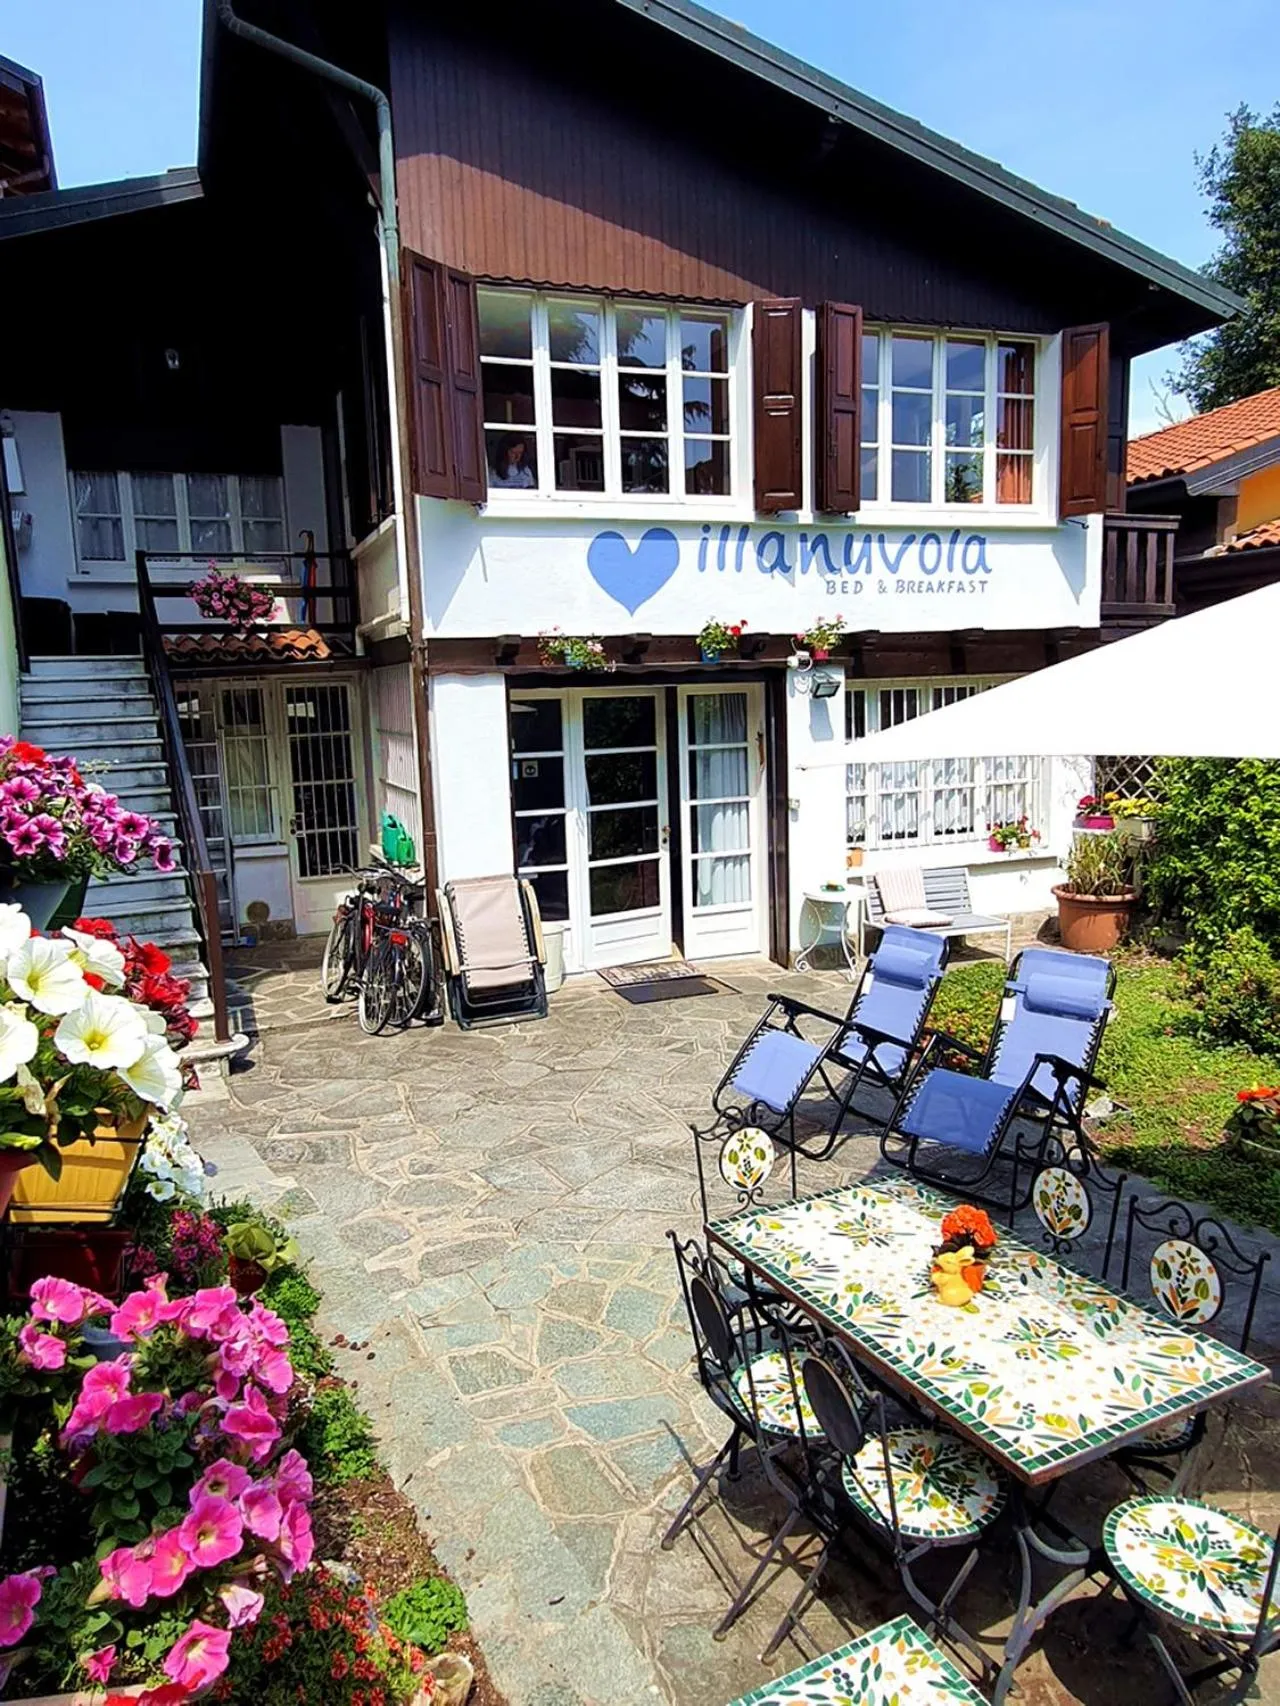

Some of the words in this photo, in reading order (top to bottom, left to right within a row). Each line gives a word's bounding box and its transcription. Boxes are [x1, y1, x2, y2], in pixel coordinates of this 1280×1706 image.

[826, 580, 863, 595] BED
[877, 579, 888, 594] &
[895, 579, 989, 594] BREAKFAST
